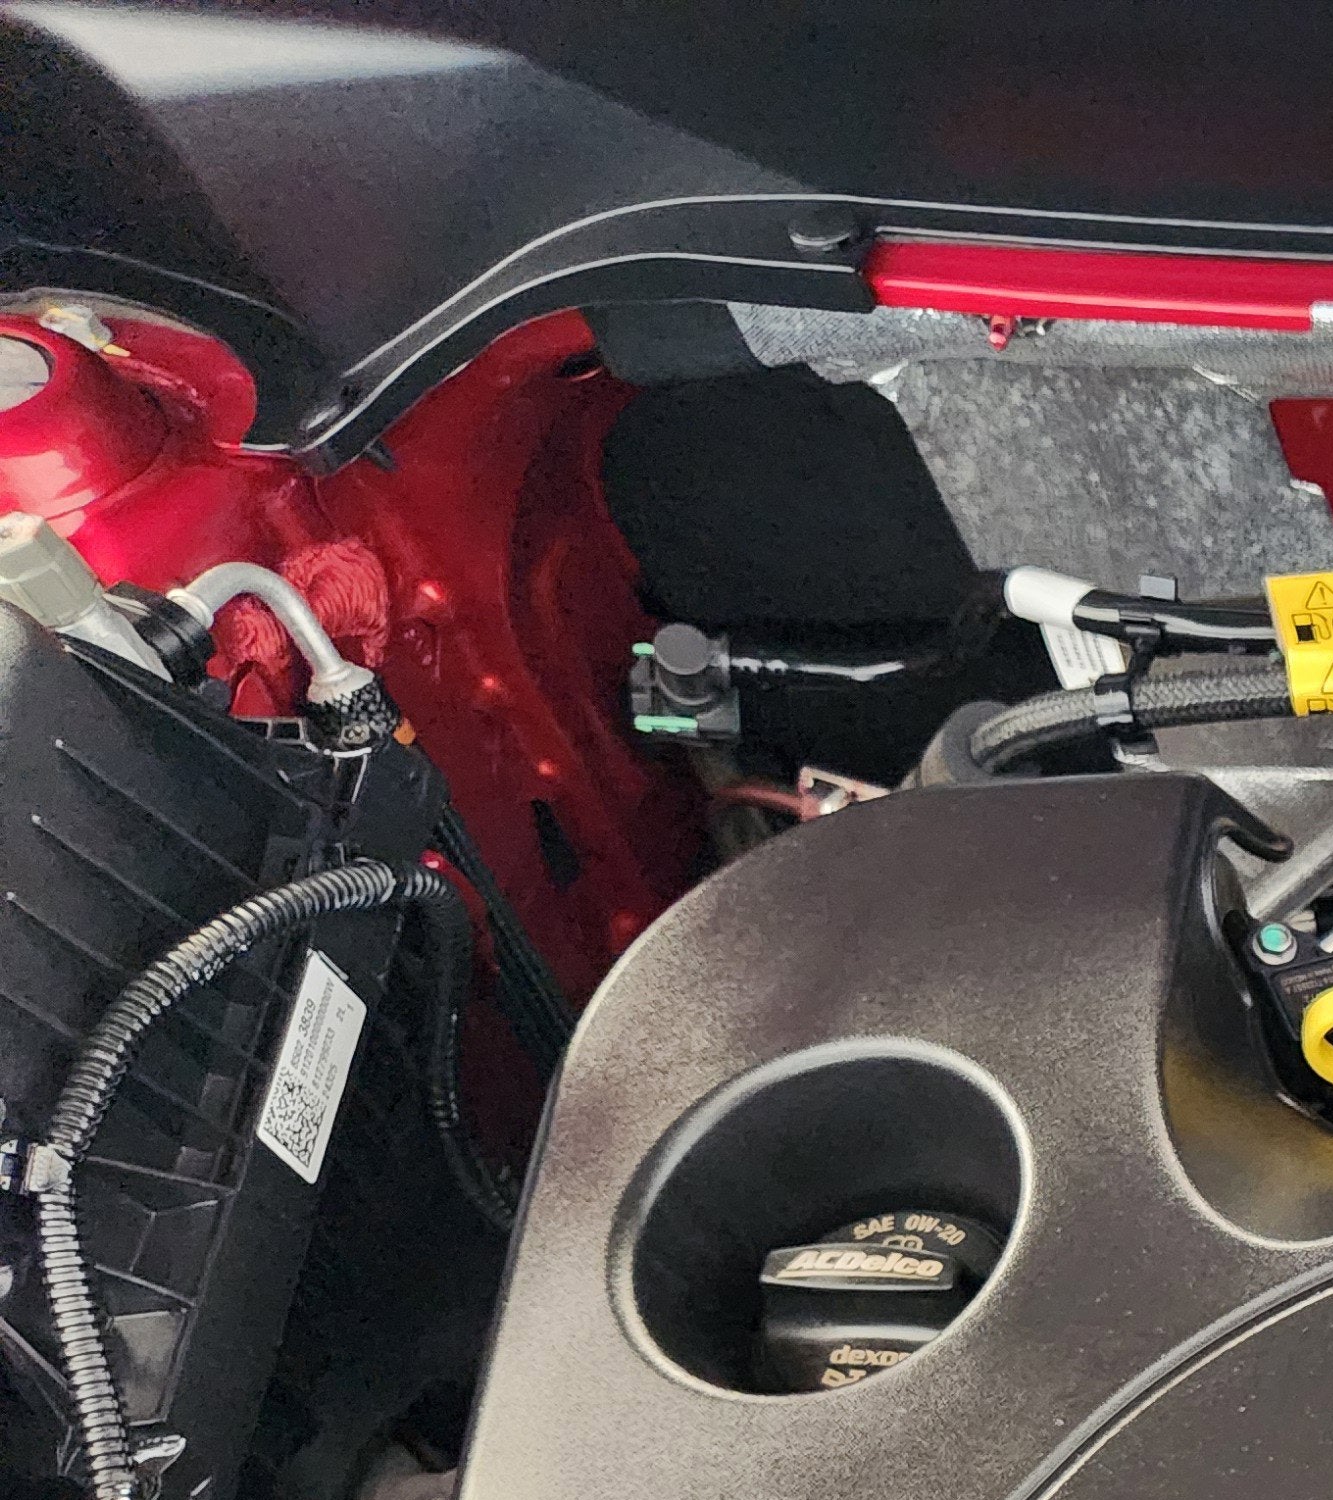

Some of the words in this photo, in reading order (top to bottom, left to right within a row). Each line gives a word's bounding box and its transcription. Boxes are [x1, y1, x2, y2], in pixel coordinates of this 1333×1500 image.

[297, 996, 316, 1038] 3839
[852, 1215, 896, 1242] SAE
[904, 1213, 967, 1247] 0W-20
[786, 1249, 945, 1279] ACDelco
